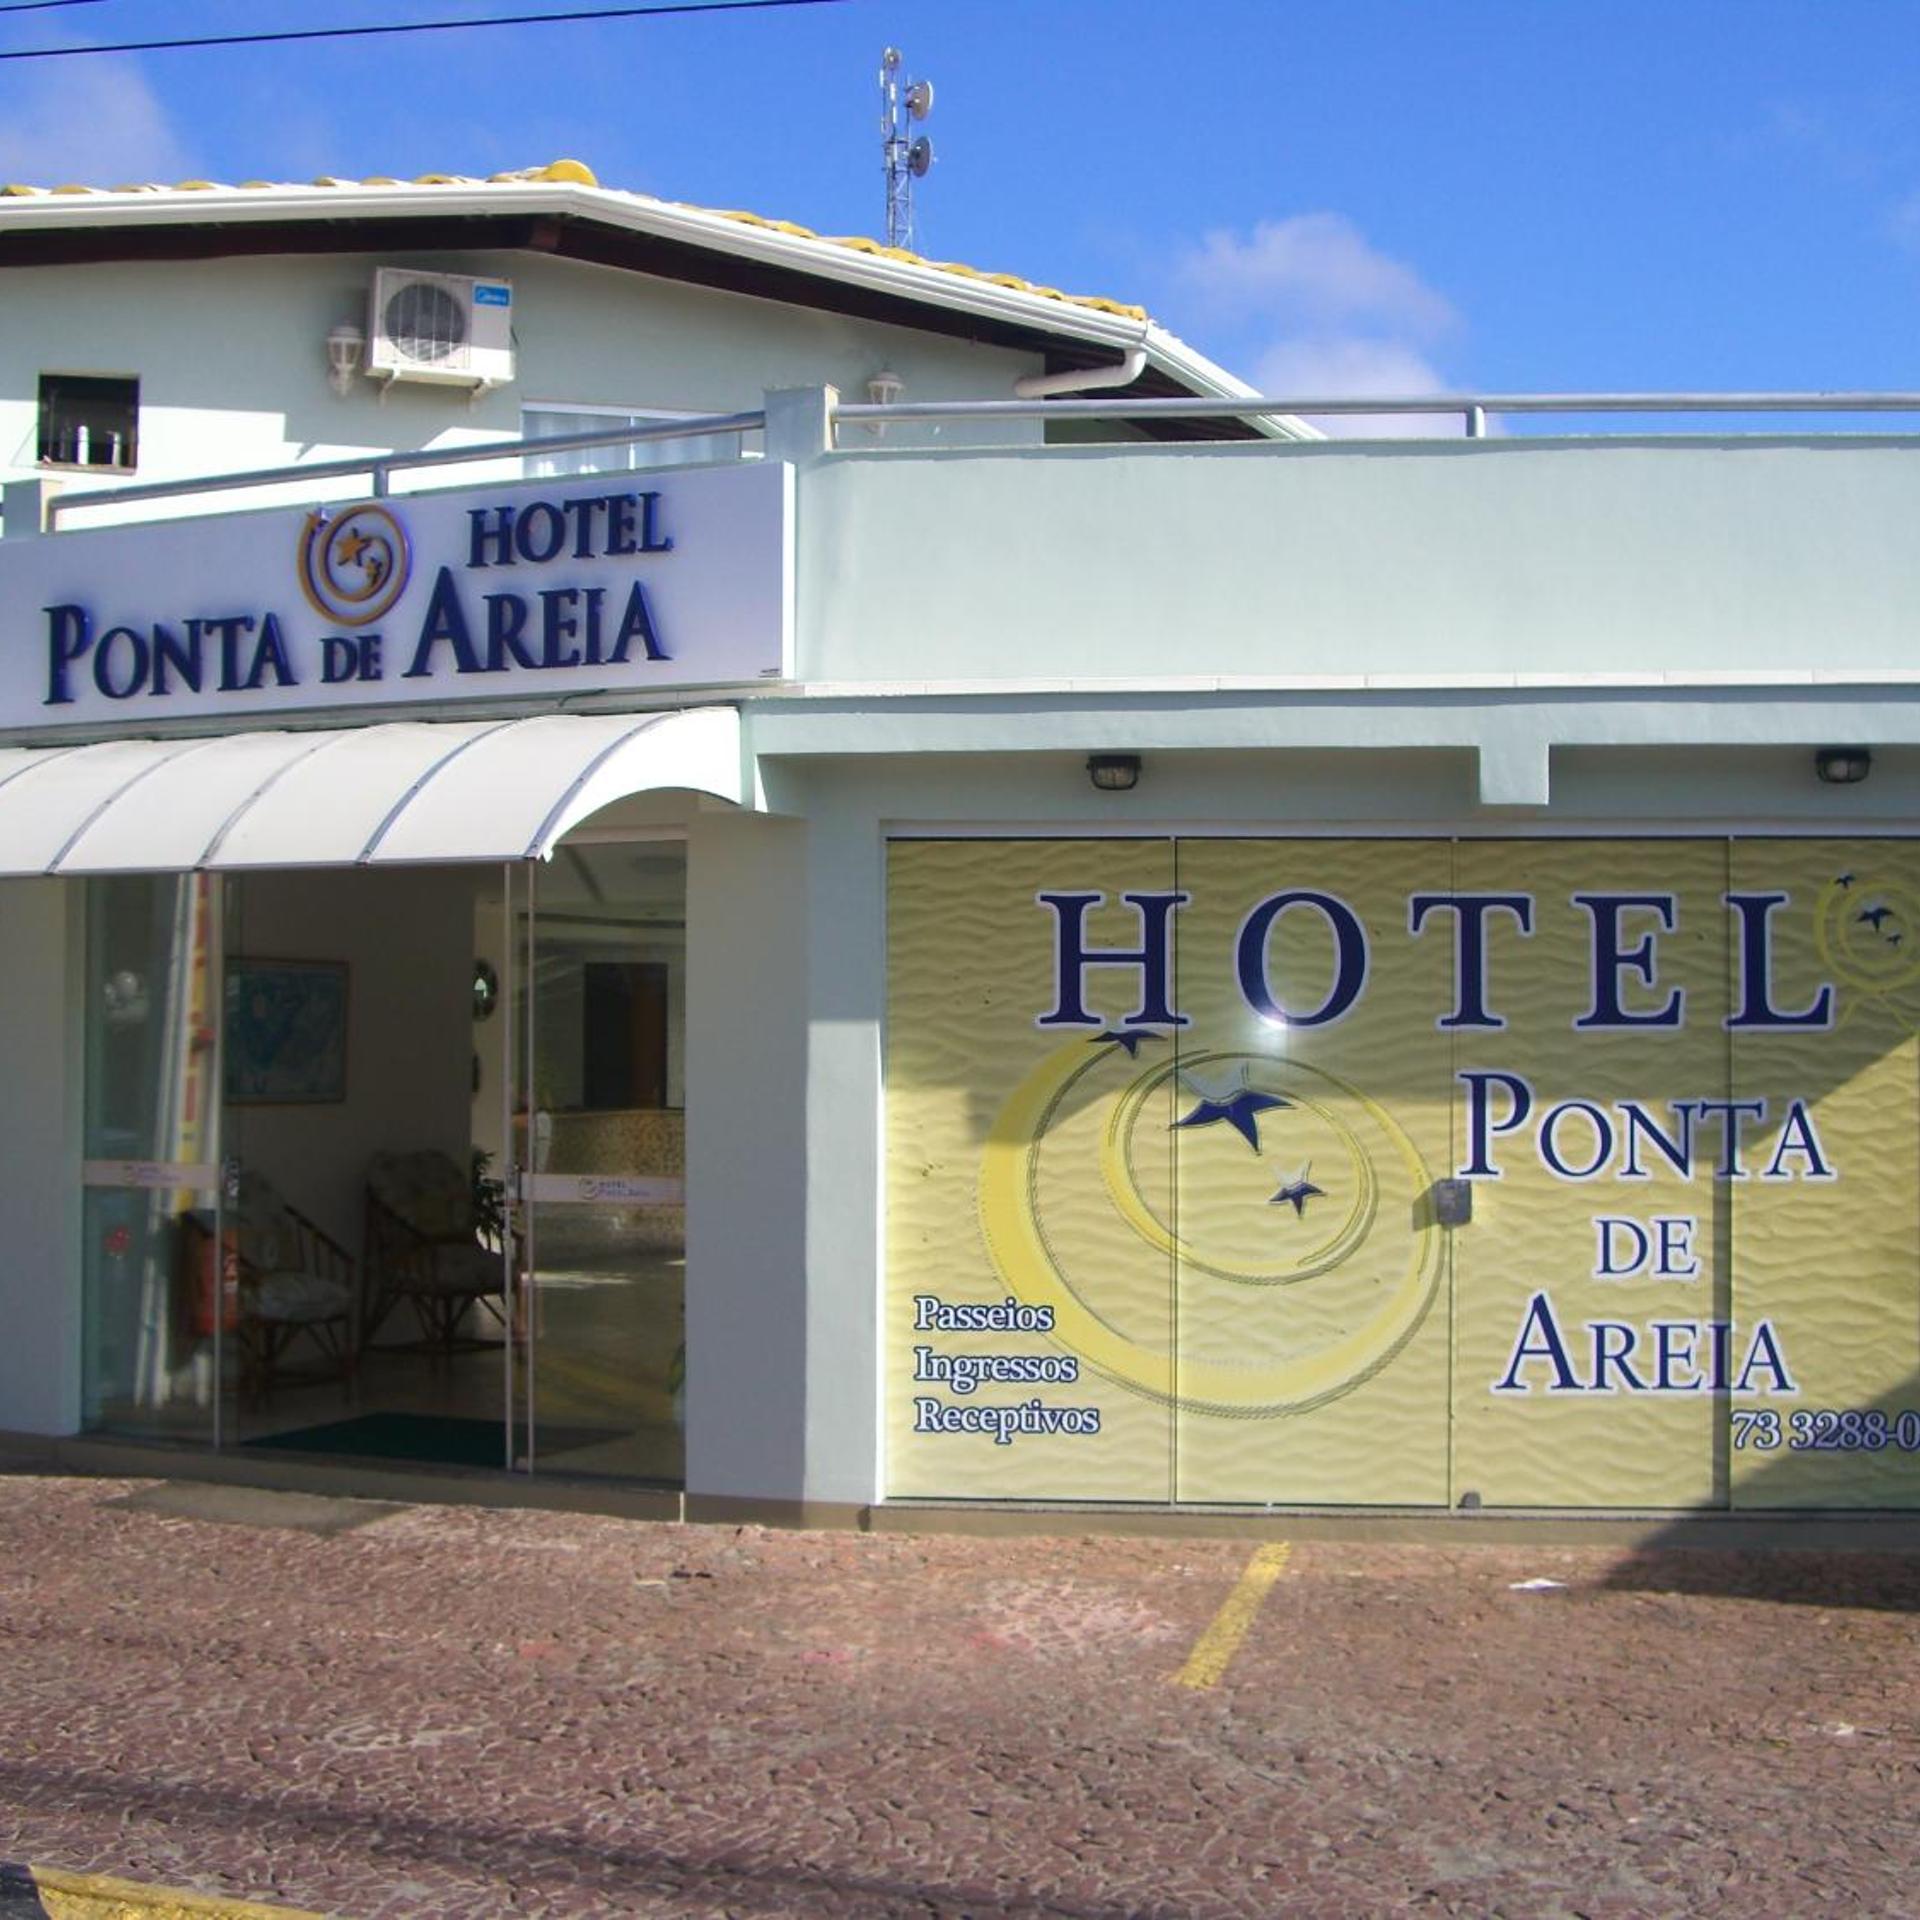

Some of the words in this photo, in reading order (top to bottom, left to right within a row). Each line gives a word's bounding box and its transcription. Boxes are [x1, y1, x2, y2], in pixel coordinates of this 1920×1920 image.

[467, 491, 673, 568] HOTEL
[42, 604, 299, 705] PONTA
[319, 634, 383, 683] DE
[402, 566, 672, 678] AREIA
[1036, 889, 1834, 1032] HOTEL
[1456, 1070, 1837, 1183] PONTA
[1592, 1215, 1699, 1281] DE
[914, 1295, 1054, 1331] Passeios
[1490, 1291, 1801, 1397] AREIA
[914, 1346, 1078, 1393] Ingressos
[914, 1397, 1100, 1444] Receptivos
[1731, 1410, 1781, 1449] 73
